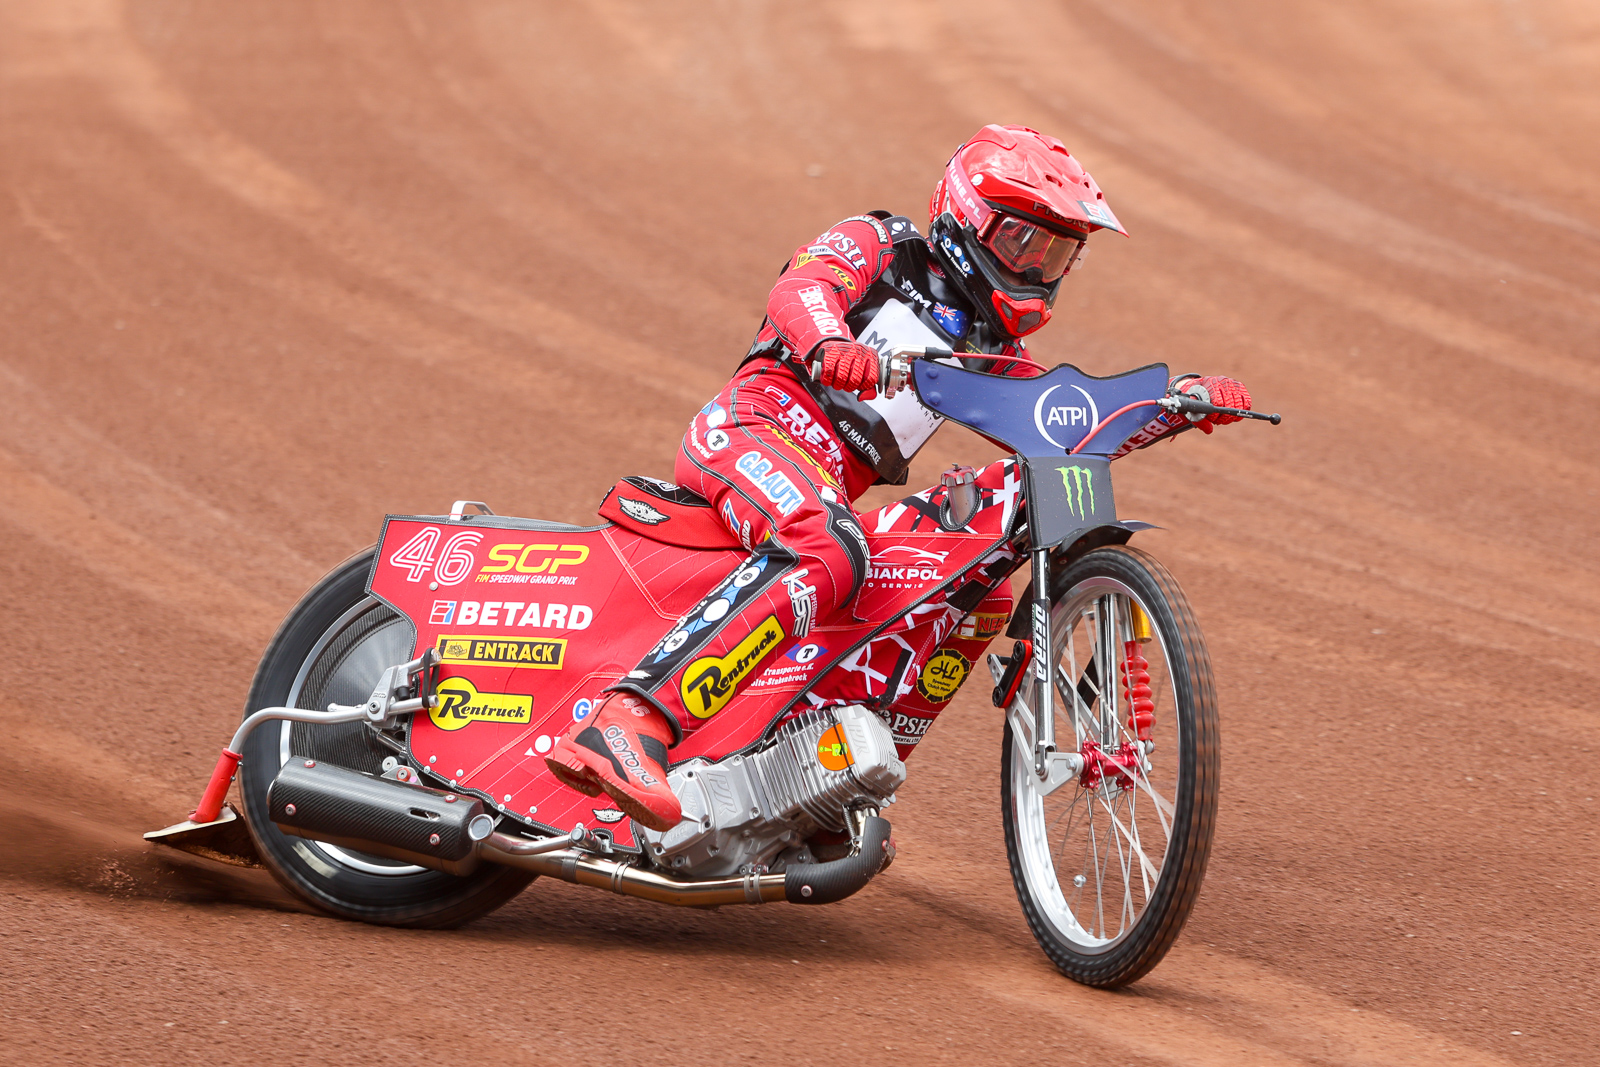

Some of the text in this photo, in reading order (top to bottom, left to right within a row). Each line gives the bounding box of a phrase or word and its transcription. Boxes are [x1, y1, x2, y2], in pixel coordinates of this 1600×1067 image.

[1046, 406, 1087, 427] ATPI
[838, 420, 851, 433] 46
[847, 428, 868, 448] MAX
[390, 526, 590, 586] 46 SGP
[475, 574, 578, 585] FIM SPEEDWAY GRAND PRIX
[456, 601, 593, 630] BETARD
[474, 642, 555, 663] ENTRACK
[687, 630, 777, 711] Rentruck
[437, 688, 526, 720] Rentruck
[622, 697, 651, 717] 46
[604, 725, 660, 788] daytona
